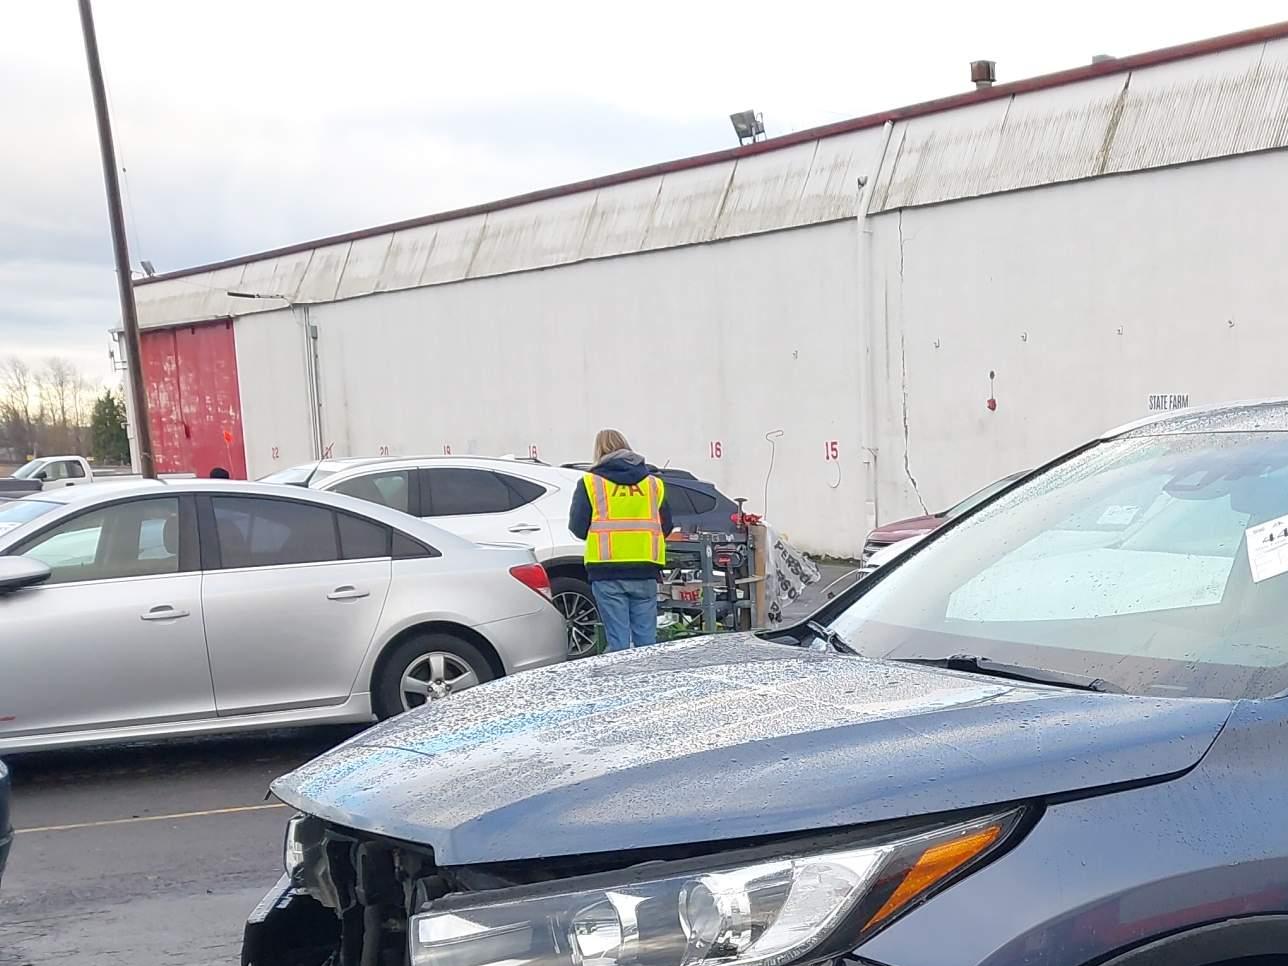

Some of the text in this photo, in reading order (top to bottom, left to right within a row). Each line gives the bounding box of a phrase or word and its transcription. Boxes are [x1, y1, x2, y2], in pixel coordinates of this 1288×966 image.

[1149, 394, 1189, 410] STATE FARM
[711, 440, 722, 459] 16
[825, 440, 839, 460] 15
